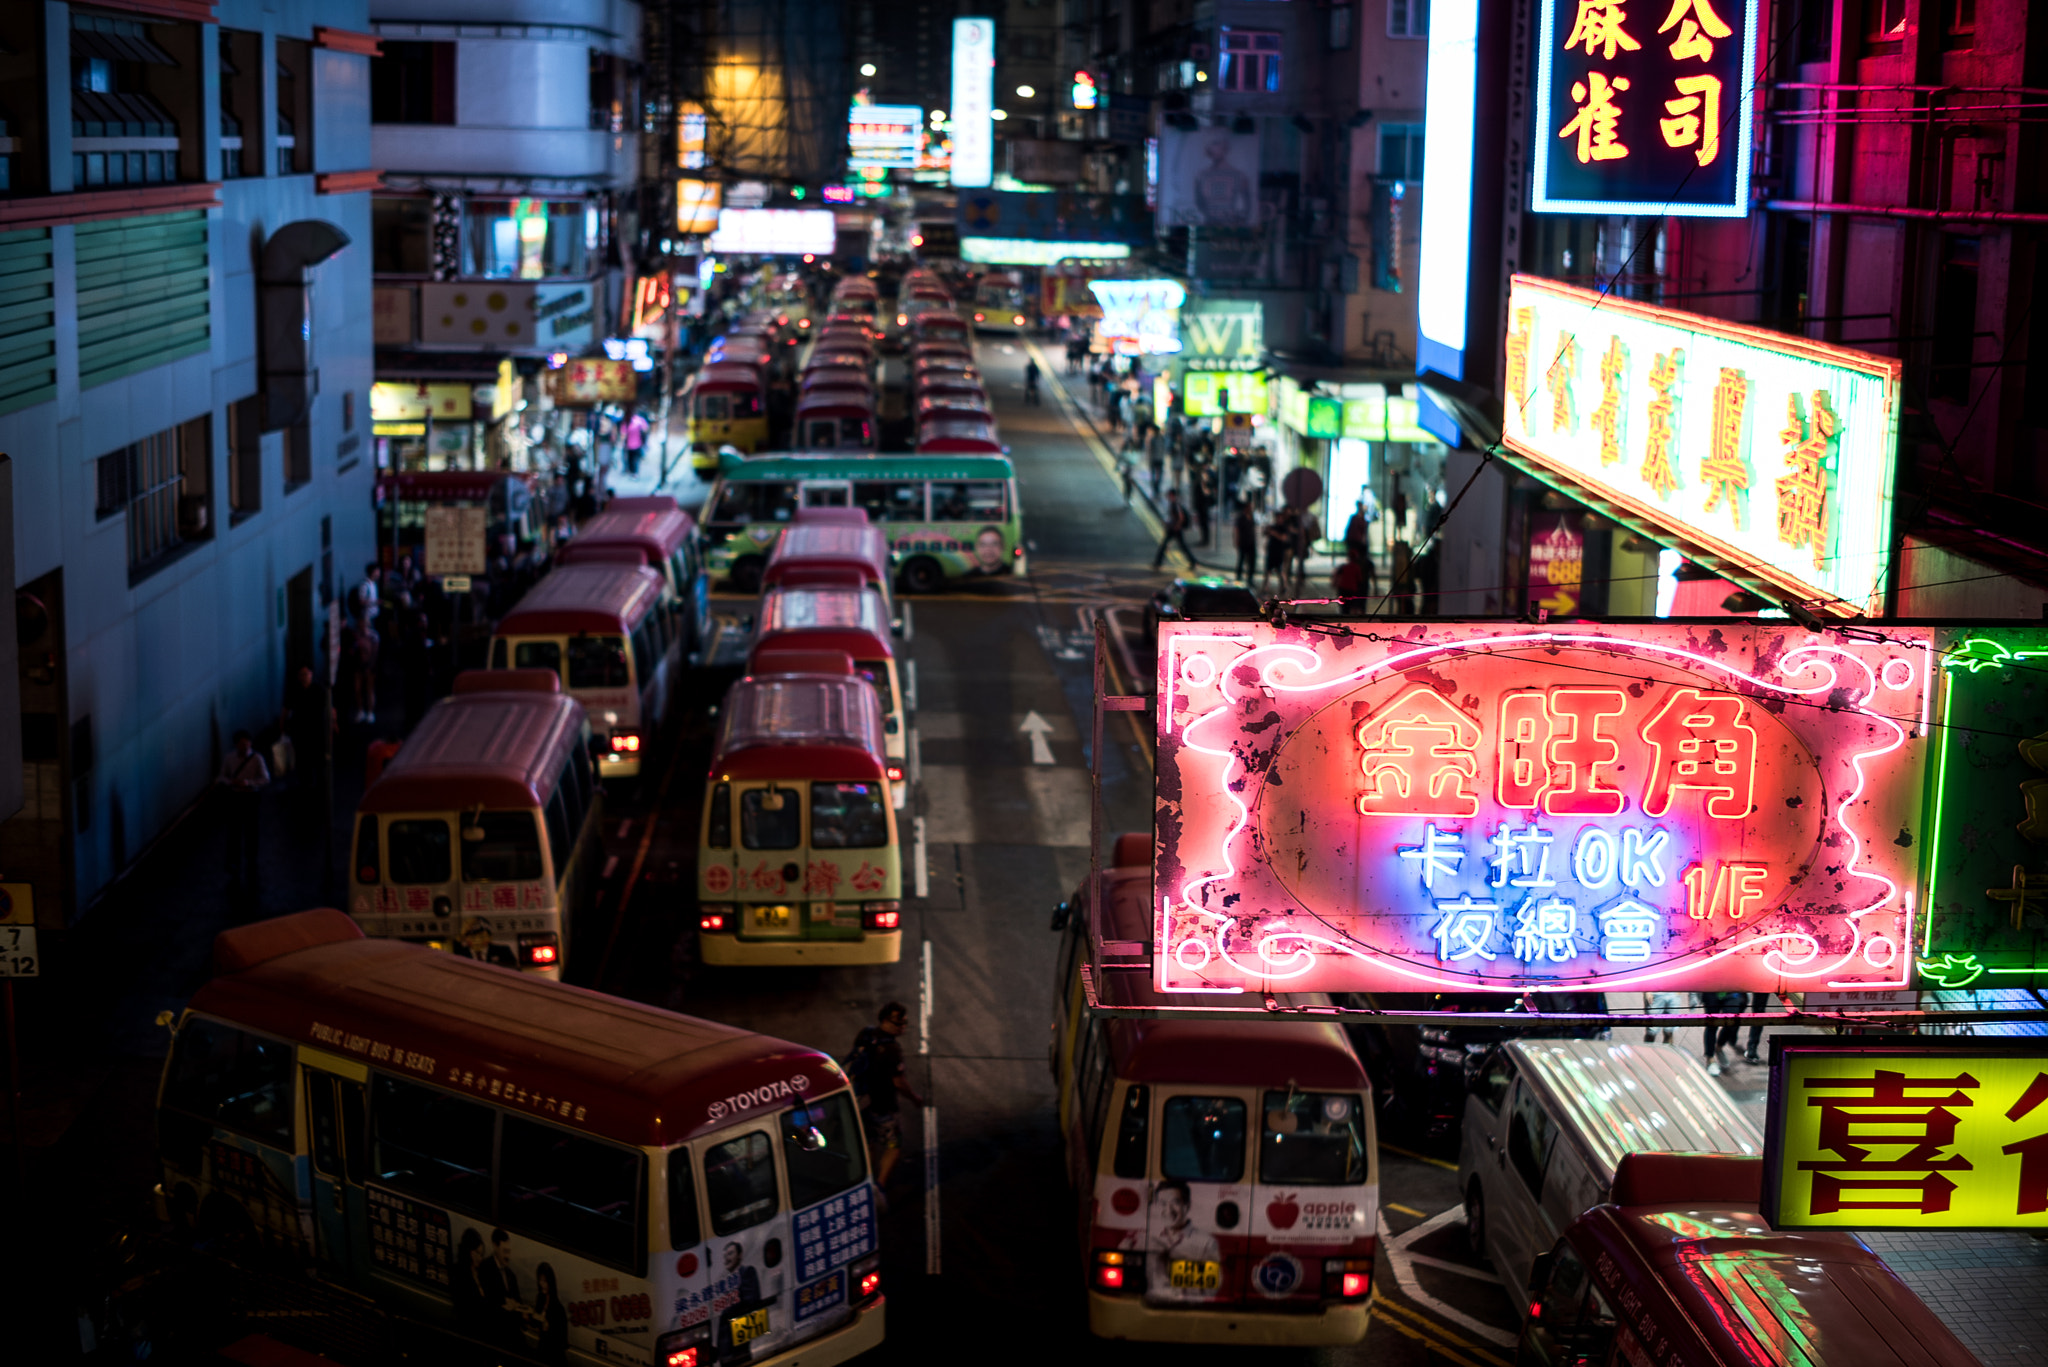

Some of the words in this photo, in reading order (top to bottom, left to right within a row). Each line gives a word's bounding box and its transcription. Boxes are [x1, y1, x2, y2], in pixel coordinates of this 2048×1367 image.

[1355, 687, 1759, 822] 金旺角
[1684, 861, 1771, 921] 1/F
[1434, 898, 1663, 964] 夜總會
[310, 1021, 343, 1048] PUBLIC
[343, 1033, 369, 1056] LIGHT
[370, 1042, 391, 1062] BUS
[405, 1050, 437, 1074] SEATS
[726, 1080, 791, 1112] TOYOTA
[1303, 1200, 1356, 1217] apple
[1596, 1251, 1620, 1288] PUBLIC
[1617, 1284, 1642, 1317] LIGHT
[1638, 1314, 1657, 1341] BUS
[1656, 1337, 1668, 1357] 16
